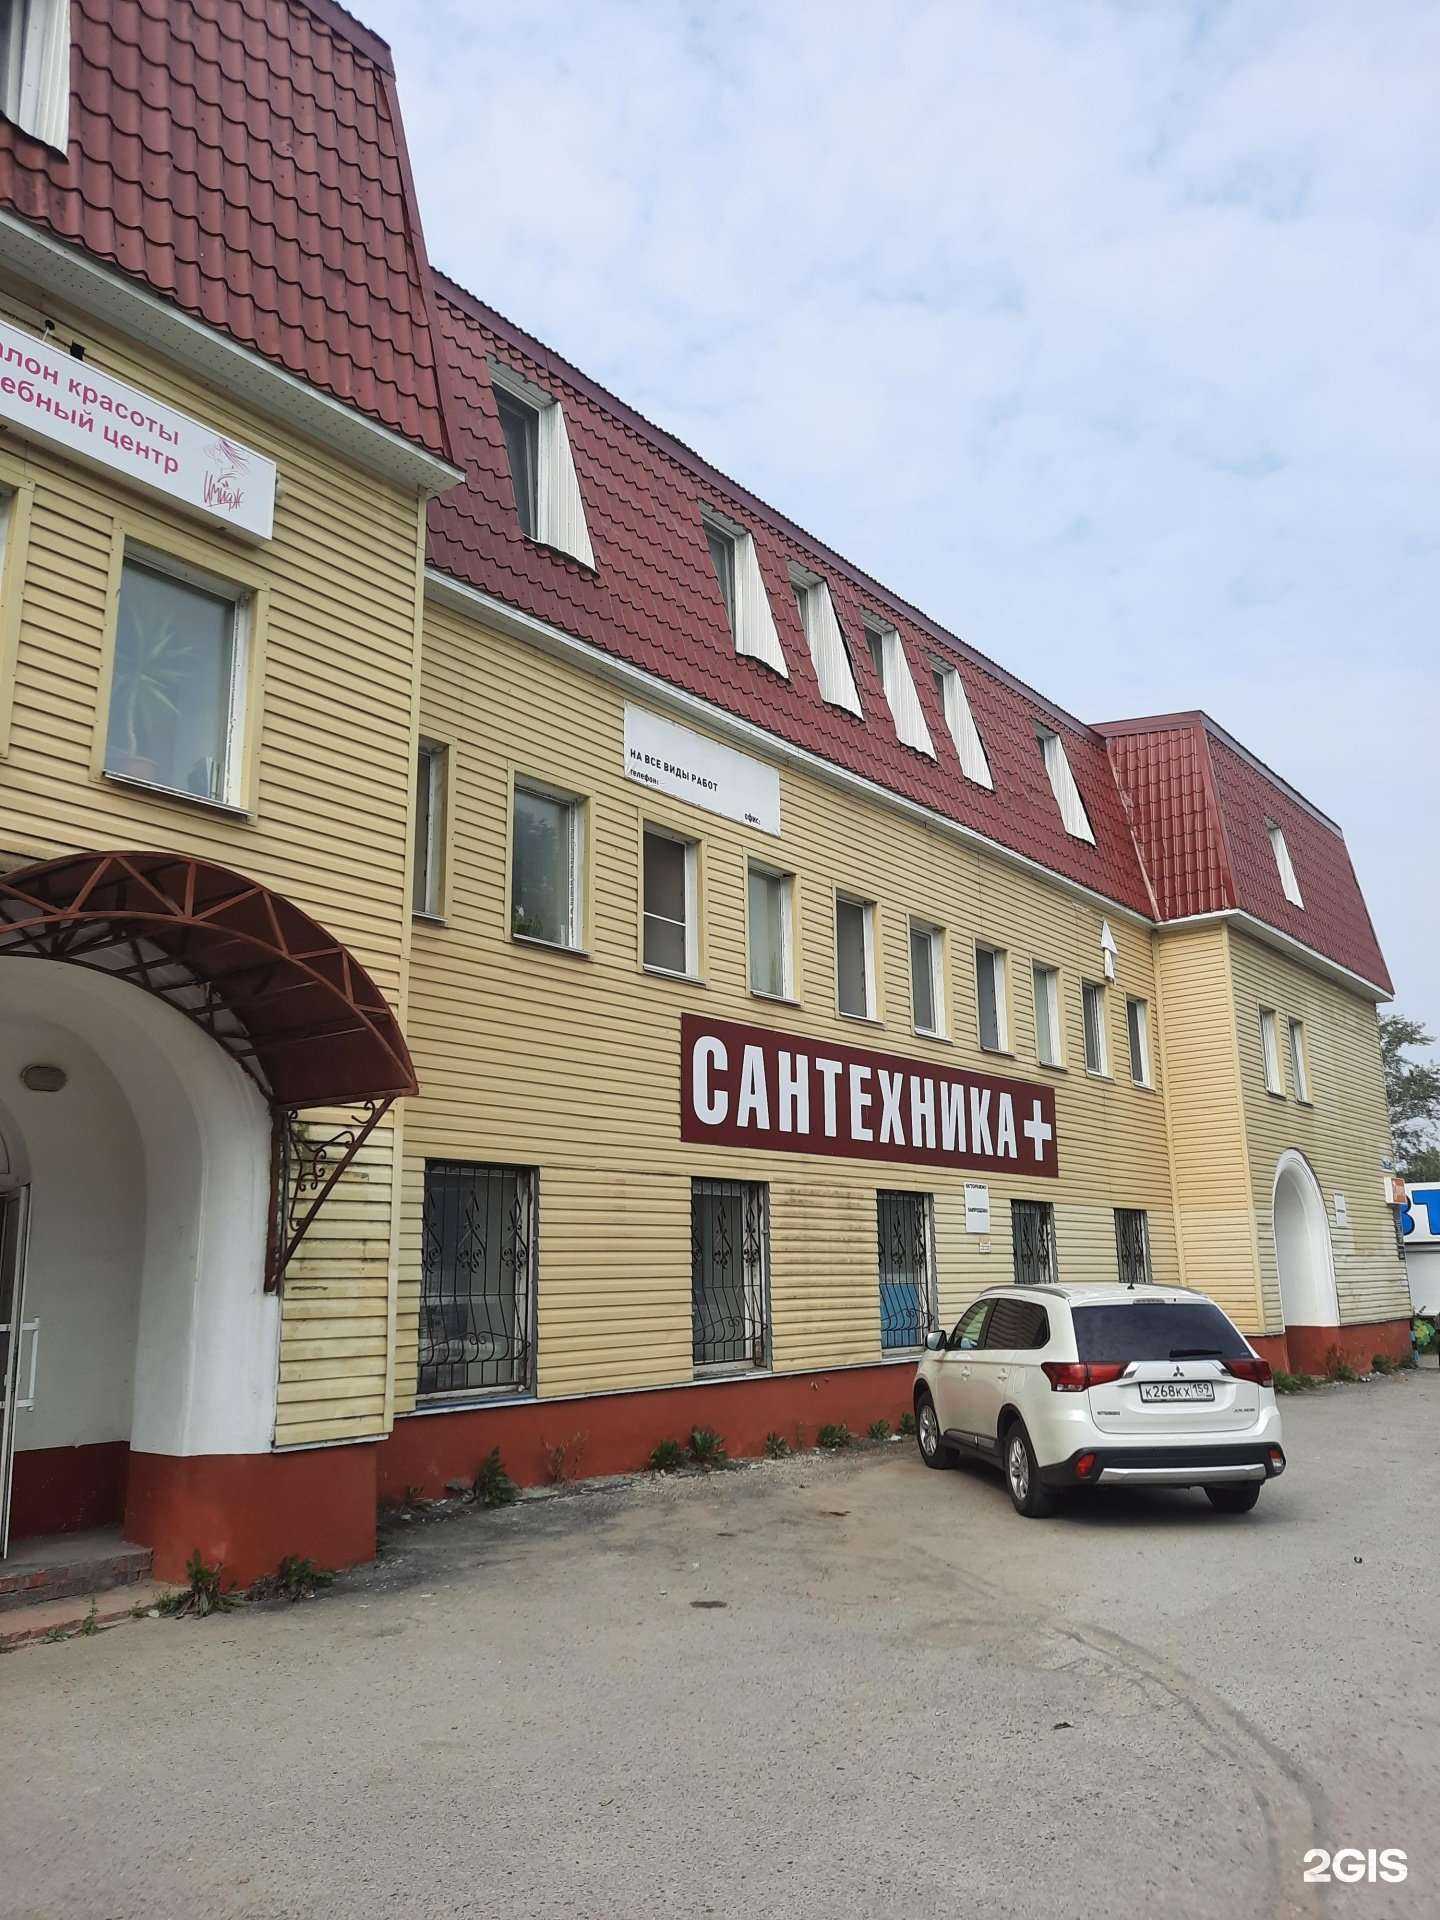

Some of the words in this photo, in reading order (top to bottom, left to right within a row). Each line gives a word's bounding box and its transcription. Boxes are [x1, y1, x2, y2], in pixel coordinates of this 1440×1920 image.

[0, 342, 58, 385] лон
[68, 378, 179, 446] красоты
[0, 376, 94, 432] ебный
[103, 425, 179, 475] центр
[630, 748, 642, 762] НА
[644, 754, 662, 769] ВСЕ
[663, 762, 690, 780] ВИДЫ
[691, 773, 718, 792] РАБОТ
